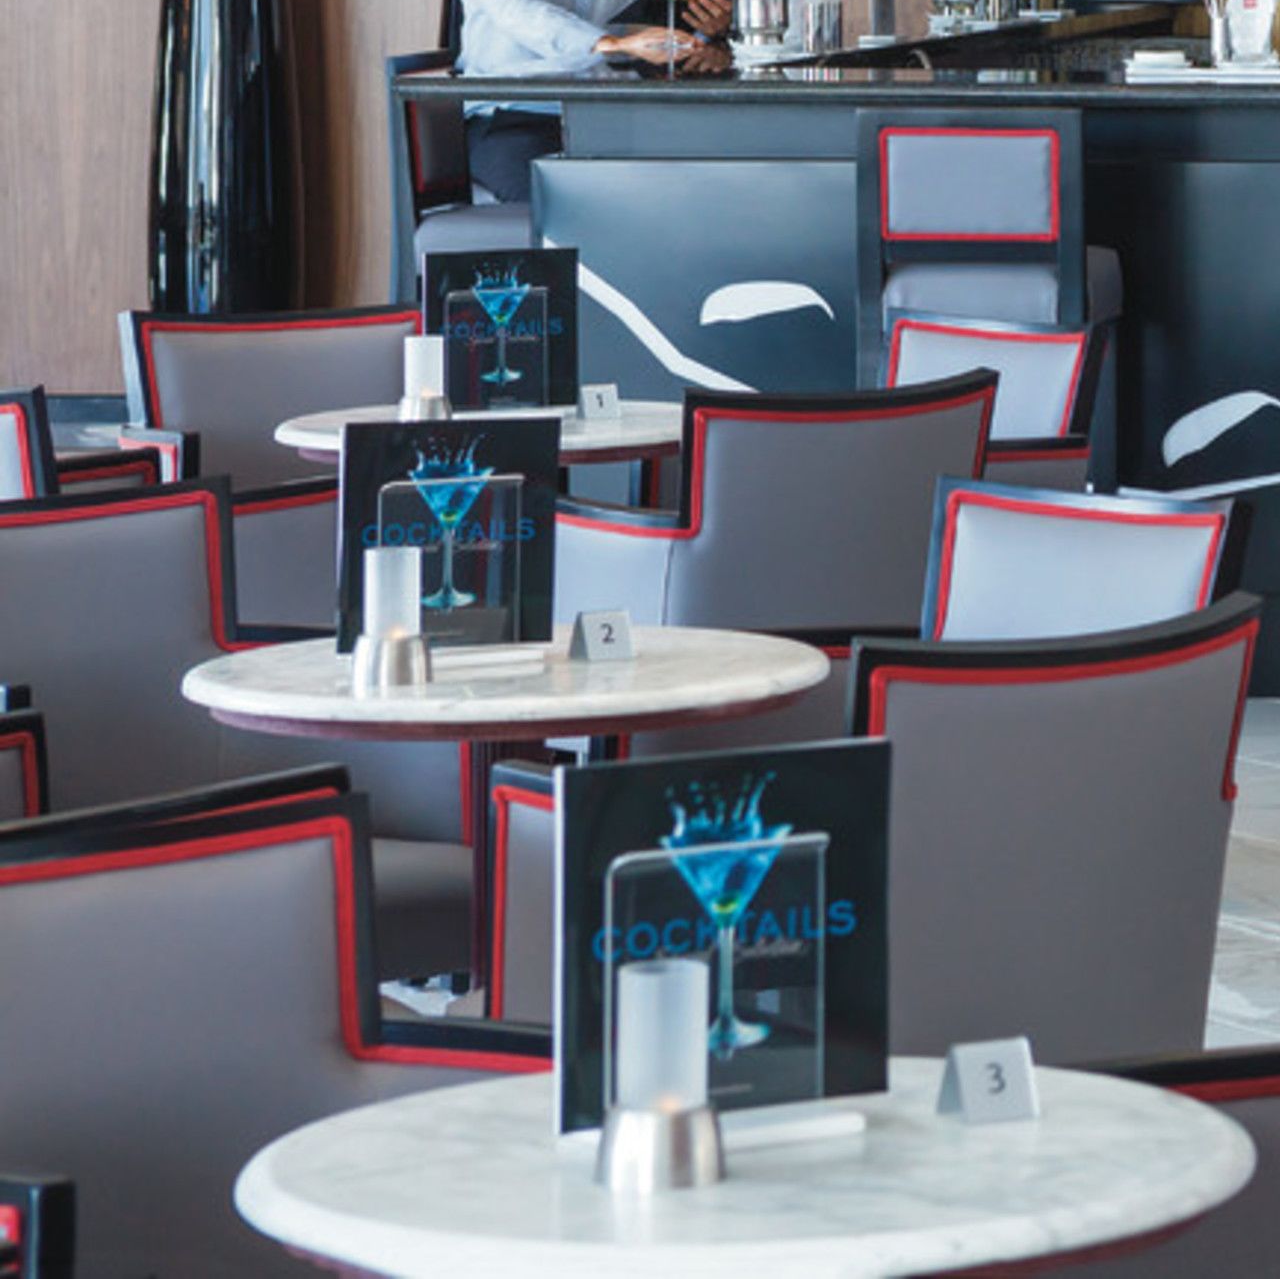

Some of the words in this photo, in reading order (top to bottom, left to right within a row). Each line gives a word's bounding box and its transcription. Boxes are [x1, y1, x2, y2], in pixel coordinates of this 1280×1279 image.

[361, 518, 536, 547] COCKTAILS
[599, 622, 616, 644] 2
[592, 899, 857, 961] COCKTAILS
[984, 1062, 1007, 1095] 3
